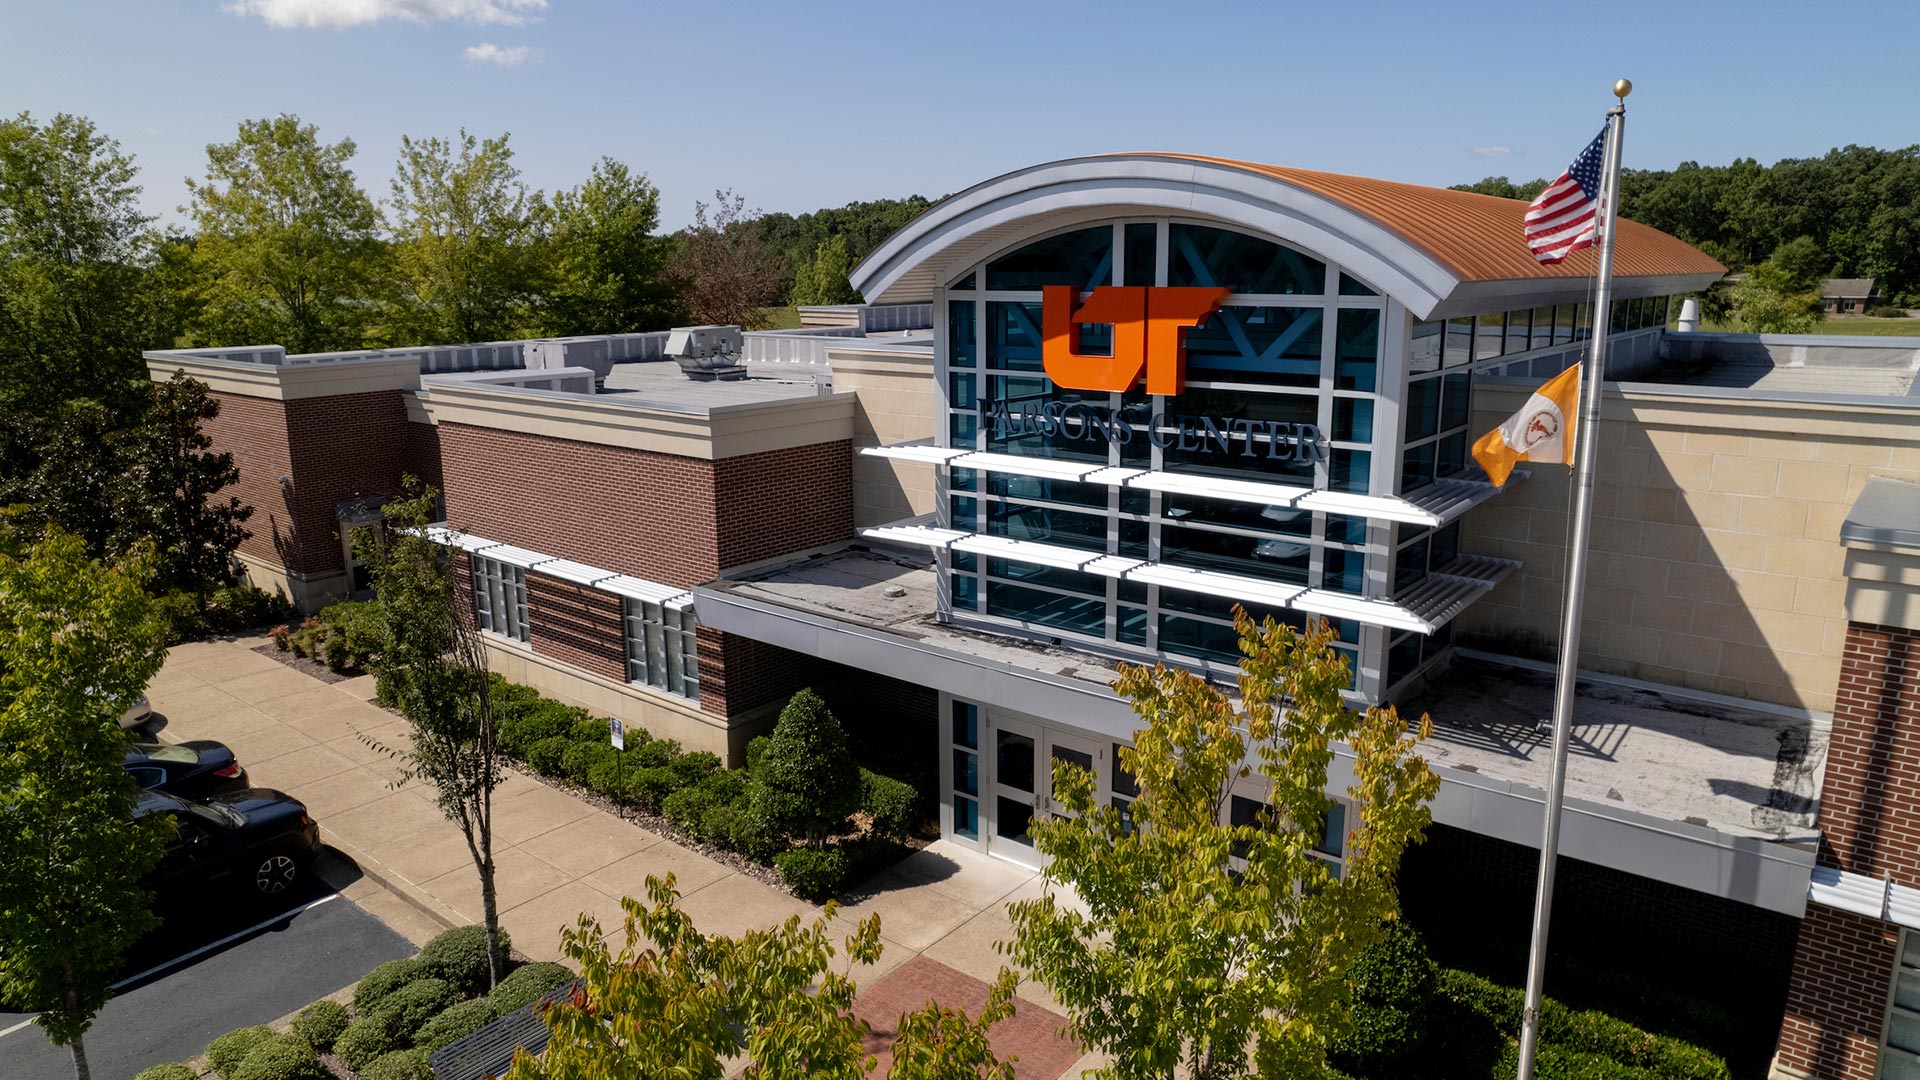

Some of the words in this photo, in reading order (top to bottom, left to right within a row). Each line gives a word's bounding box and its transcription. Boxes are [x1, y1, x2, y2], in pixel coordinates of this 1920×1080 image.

[1042, 285, 1231, 396] UT
[979, 398, 1133, 445] PARSONS
[1149, 413, 1327, 462] CENTER
